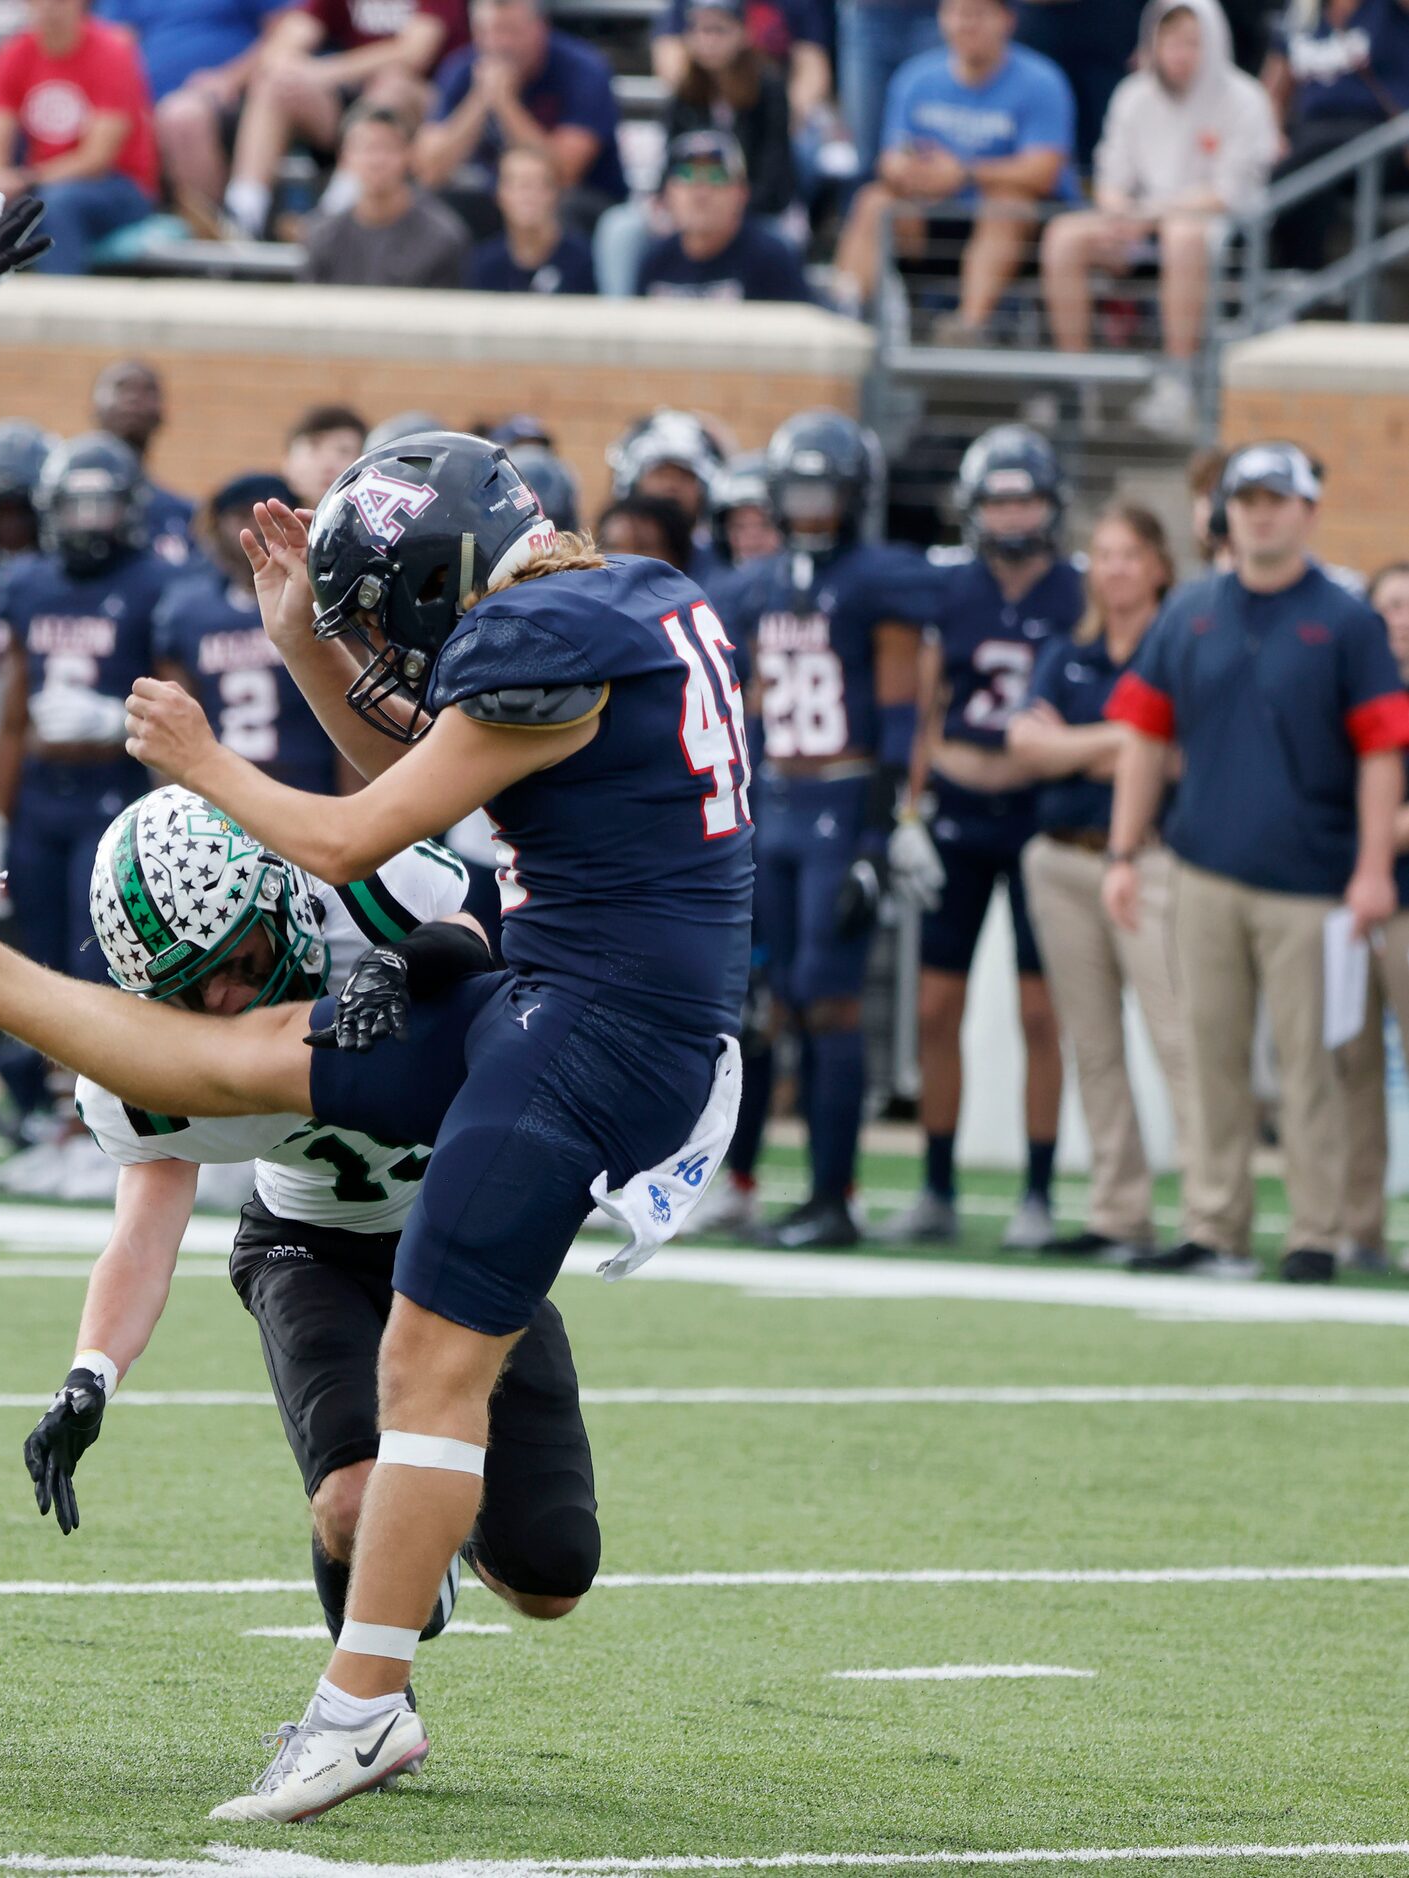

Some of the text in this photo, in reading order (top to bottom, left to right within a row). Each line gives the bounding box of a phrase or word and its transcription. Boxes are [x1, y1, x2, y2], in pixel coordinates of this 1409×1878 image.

[345, 467, 438, 557] A
[219, 667, 280, 760] 2
[757, 648, 849, 759] 28
[965, 640, 1034, 730] 3
[146, 942, 193, 976] DRAGONS
[672, 1150, 709, 1187] 46
[302, 1763, 338, 1784] PHANTOM
